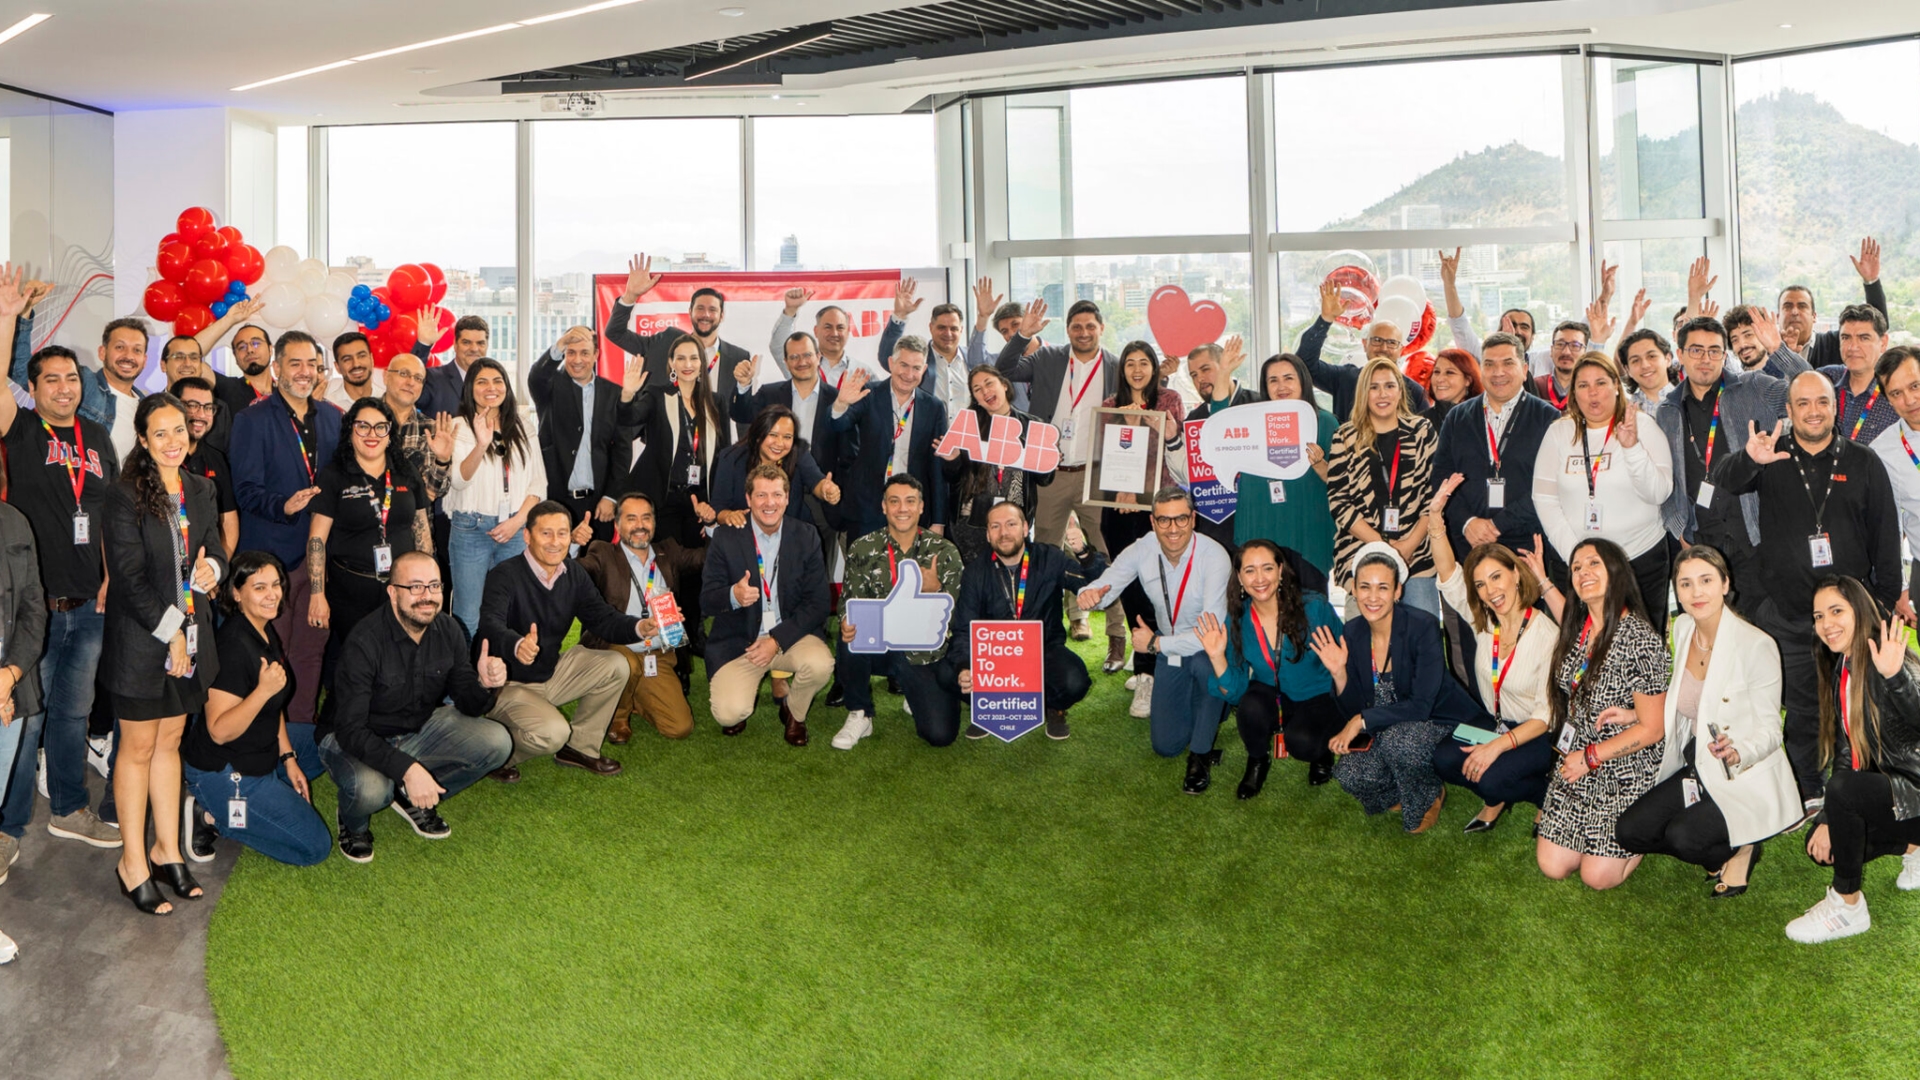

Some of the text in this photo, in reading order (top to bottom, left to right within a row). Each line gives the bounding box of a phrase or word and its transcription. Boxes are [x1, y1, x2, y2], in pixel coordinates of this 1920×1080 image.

[1267, 414, 1291, 422] Great
[1223, 427, 1250, 439] ABB
[936, 409, 1060, 473] ABB
[1268, 447, 1298, 455] Certified
[976, 627, 1024, 641] Great
[977, 642, 1024, 656] Place
[976, 658, 995, 671] To
[977, 697, 1037, 710] Certified
